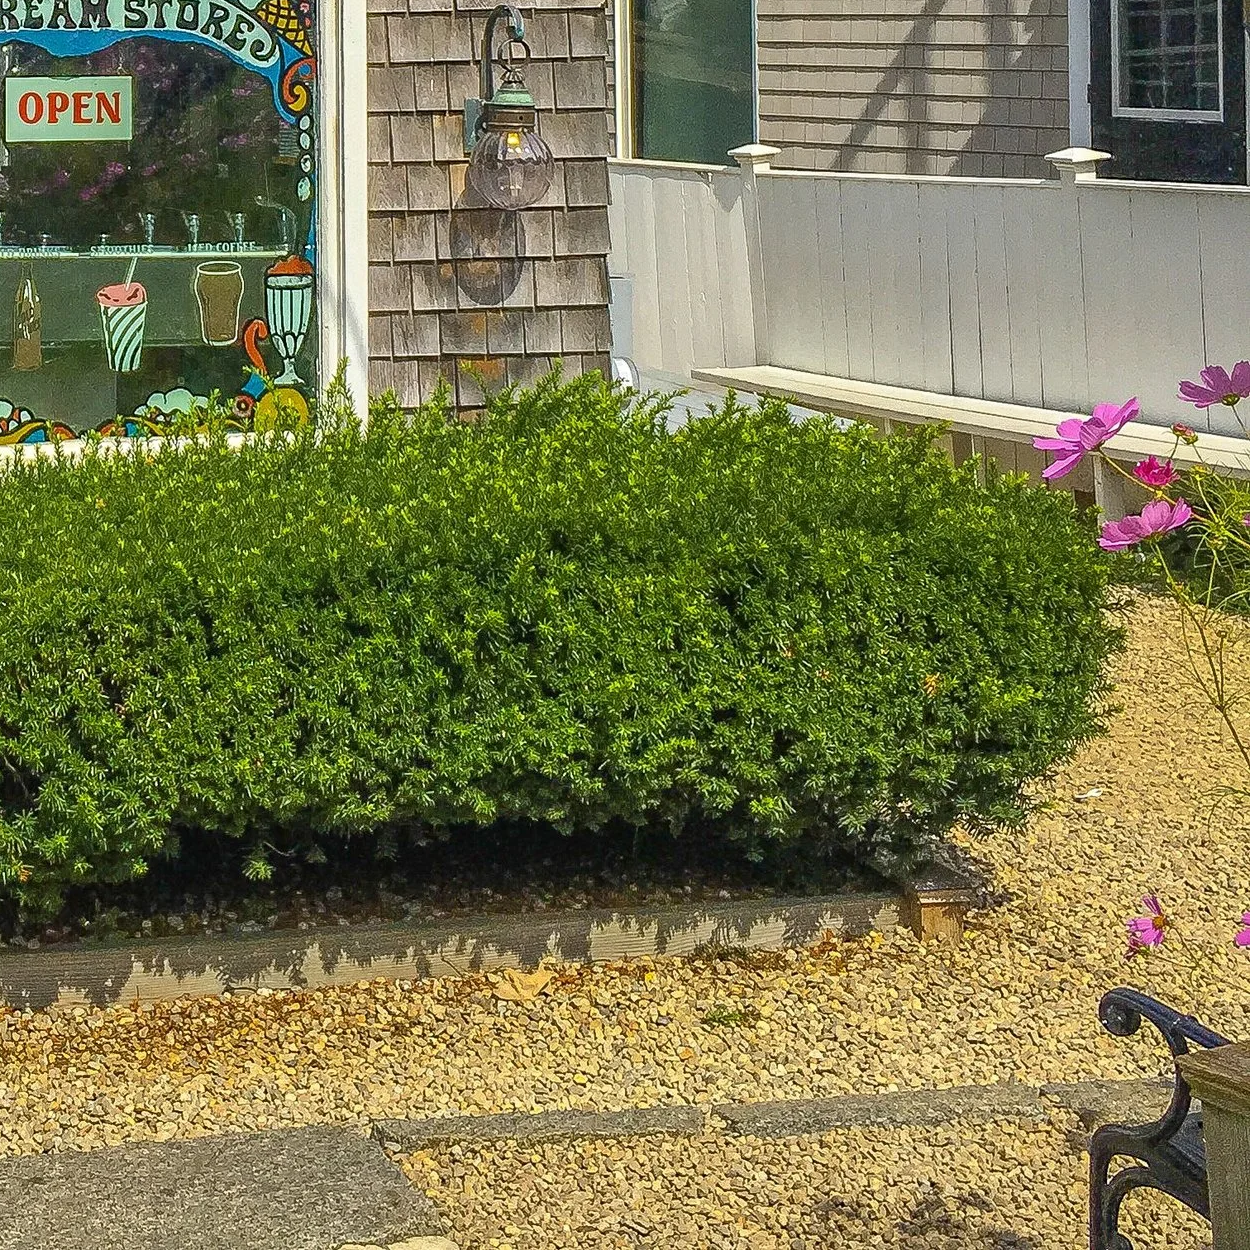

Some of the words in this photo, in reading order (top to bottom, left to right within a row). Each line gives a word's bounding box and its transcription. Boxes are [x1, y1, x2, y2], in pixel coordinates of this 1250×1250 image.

[18, 92, 121, 125] OPEN
[186, 242, 213, 253] ICED
[215, 240, 256, 253] COFFEE
